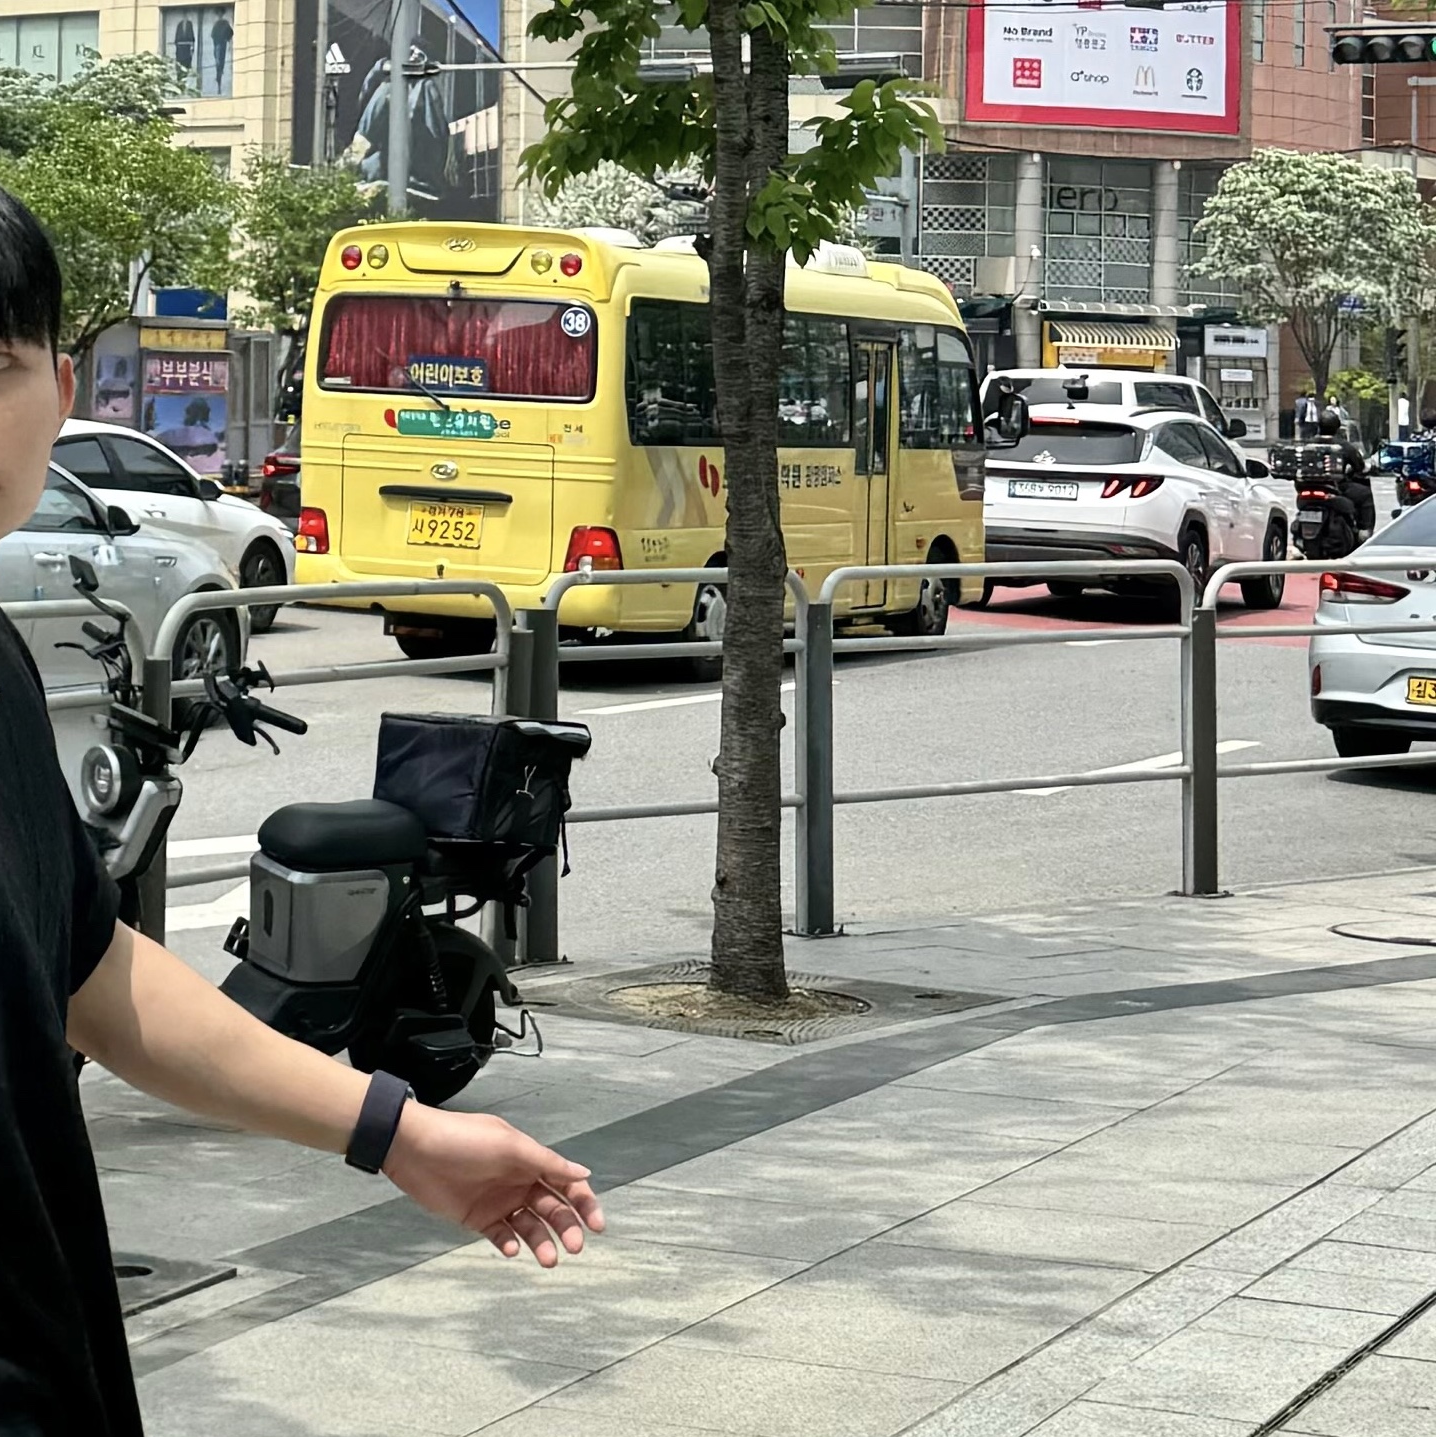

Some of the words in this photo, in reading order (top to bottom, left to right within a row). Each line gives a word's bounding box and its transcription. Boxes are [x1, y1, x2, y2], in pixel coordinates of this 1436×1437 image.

[1021, 27, 1053, 37] Brand
[564, 312, 586, 332] 38
[410, 362, 485, 388] 어린이보호
